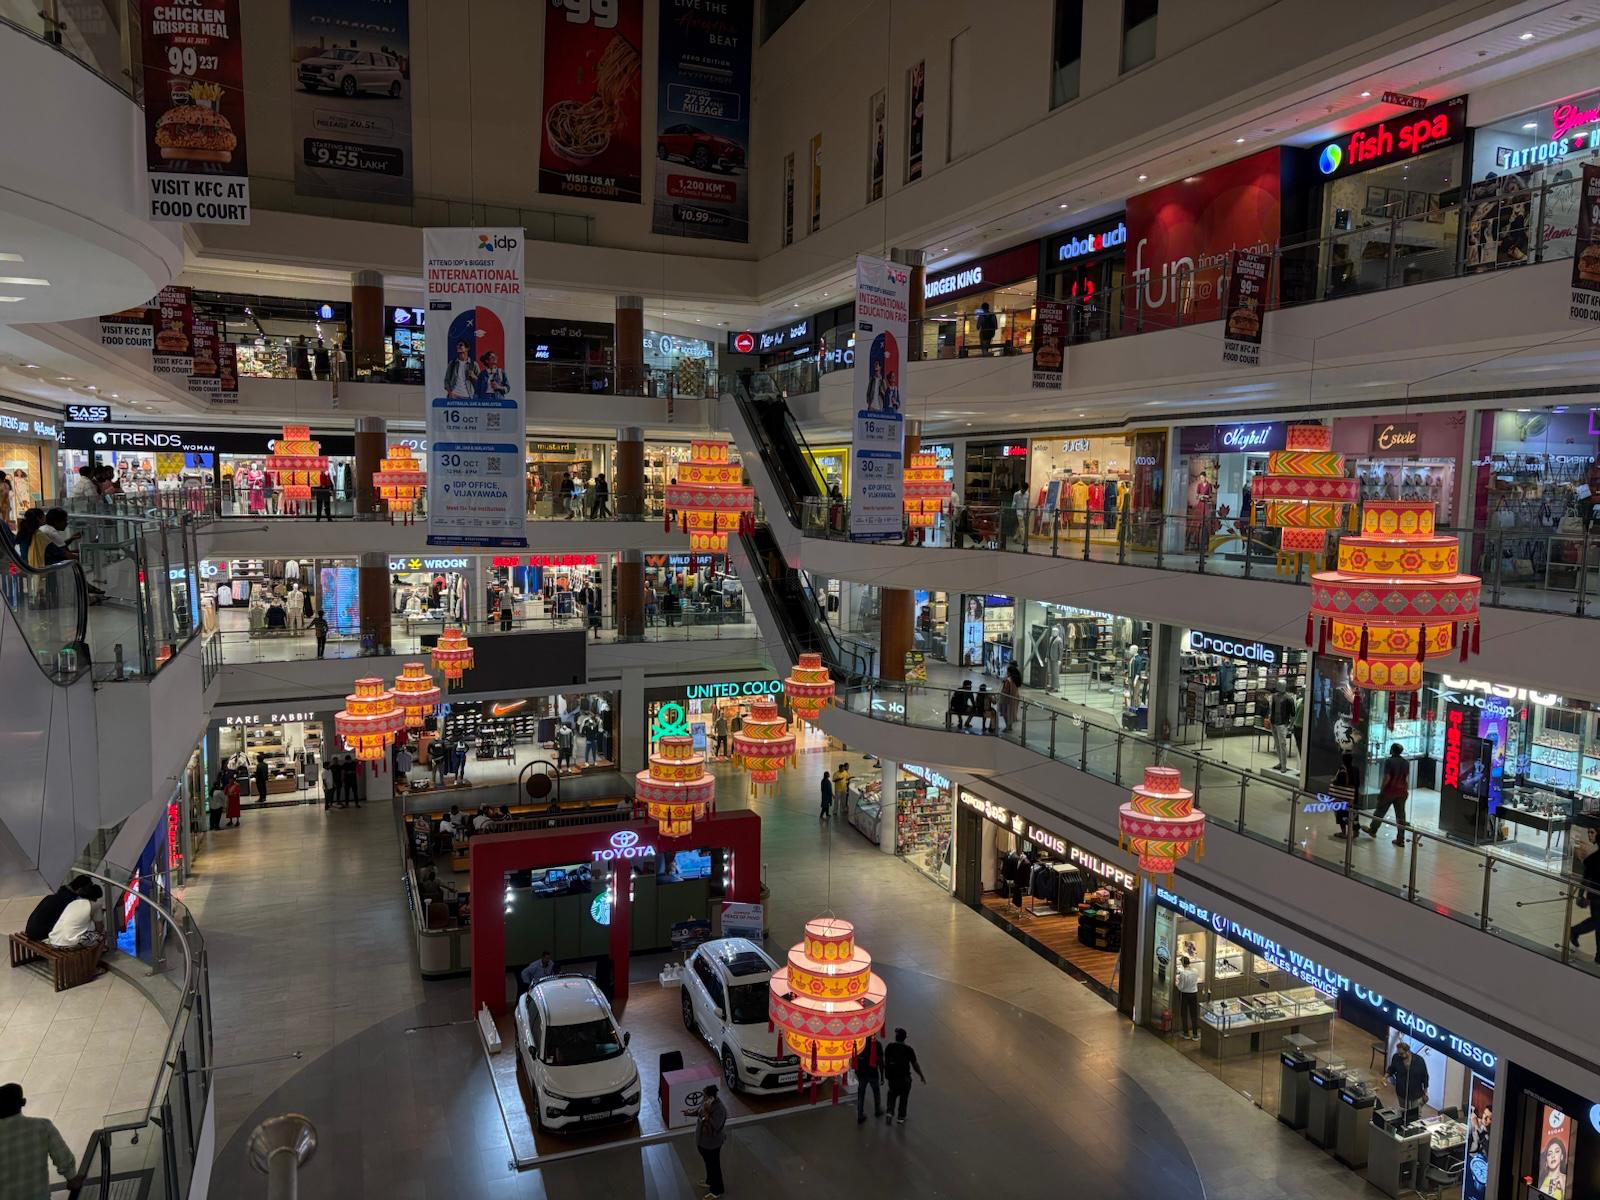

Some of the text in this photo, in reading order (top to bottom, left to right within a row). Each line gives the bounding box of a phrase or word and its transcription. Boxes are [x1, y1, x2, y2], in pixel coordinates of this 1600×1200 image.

[153, 6, 225, 23] CHICKEN
[705, 1, 728, 15] THE
[152, 20, 230, 39] KRISPER MEAL
[709, 33, 739, 48] BEAT
[199, 55, 220, 71] 237
[683, 93, 711, 106] 27.97
[682, 103, 724, 117] MILEAGE
[1347, 113, 1449, 167] fish spa
[1502, 138, 1569, 170] TATTOOS
[565, 173, 616, 187] VISIT US AT
[679, 178, 706, 192] 1,200
[151, 178, 246, 199] VISIT KFC AT
[561, 181, 620, 197] FOOD COURT
[151, 200, 248, 220] FOOD COURT
[494, 234, 517, 252] idp
[1059, 222, 1127, 261] robotouch
[428, 268, 519, 280] INTERNATIONAL
[956, 266, 982, 291] KING
[1132, 238, 1195, 310] fun
[428, 282, 520, 294] EDUCATION FAIR
[1240, 279, 1252, 295] 99
[859, 292, 907, 312] INTERNATIONAL
[1571, 292, 1590, 305] VISIT
[161, 307, 174, 319] 99
[859, 304, 907, 322] EDUCATION FAIR
[1571, 307, 1589, 320] FOOD
[101, 325, 151, 336] VISIT KFC AT
[1043, 323, 1052, 335] 99
[101, 336, 153, 347] FOOD COURT
[193, 337, 204, 348] 99
[1224, 341, 1260, 354] VISIT KFC AT
[1223, 352, 1259, 365] FOOD COURT
[69, 406, 108, 417] SASS
[443, 410, 460, 423] 16
[864, 421, 875, 433] 16
[108, 432, 181, 447] TRENDS
[1223, 426, 1272, 450] Maybell
[1378, 424, 1417, 449] Estele
[537, 442, 570, 450] mustard
[441, 454, 479, 468] 30 OCT
[862, 459, 874, 472] 30
[468, 481, 500, 490] OFFICE,
[453, 490, 508, 499] VIJAYAWADA
[424, 558, 469, 569] WROGN
[530, 554, 583, 566] KILLER
[1190, 630, 1275, 663] Crocodile
[687, 682, 740, 699] UNITED
[226, 712, 314, 725] RARE RABBIT
[592, 845, 656, 861] TOYOTA
[1028, 825, 1134, 890] LOUIS PHILIPPE
[1232, 922, 1390, 1013] KAMAL WATCH CO.
[1263, 951, 1339, 1000] SALES & SERVICE
[1396, 1008, 1498, 1068] RADO TISSO
